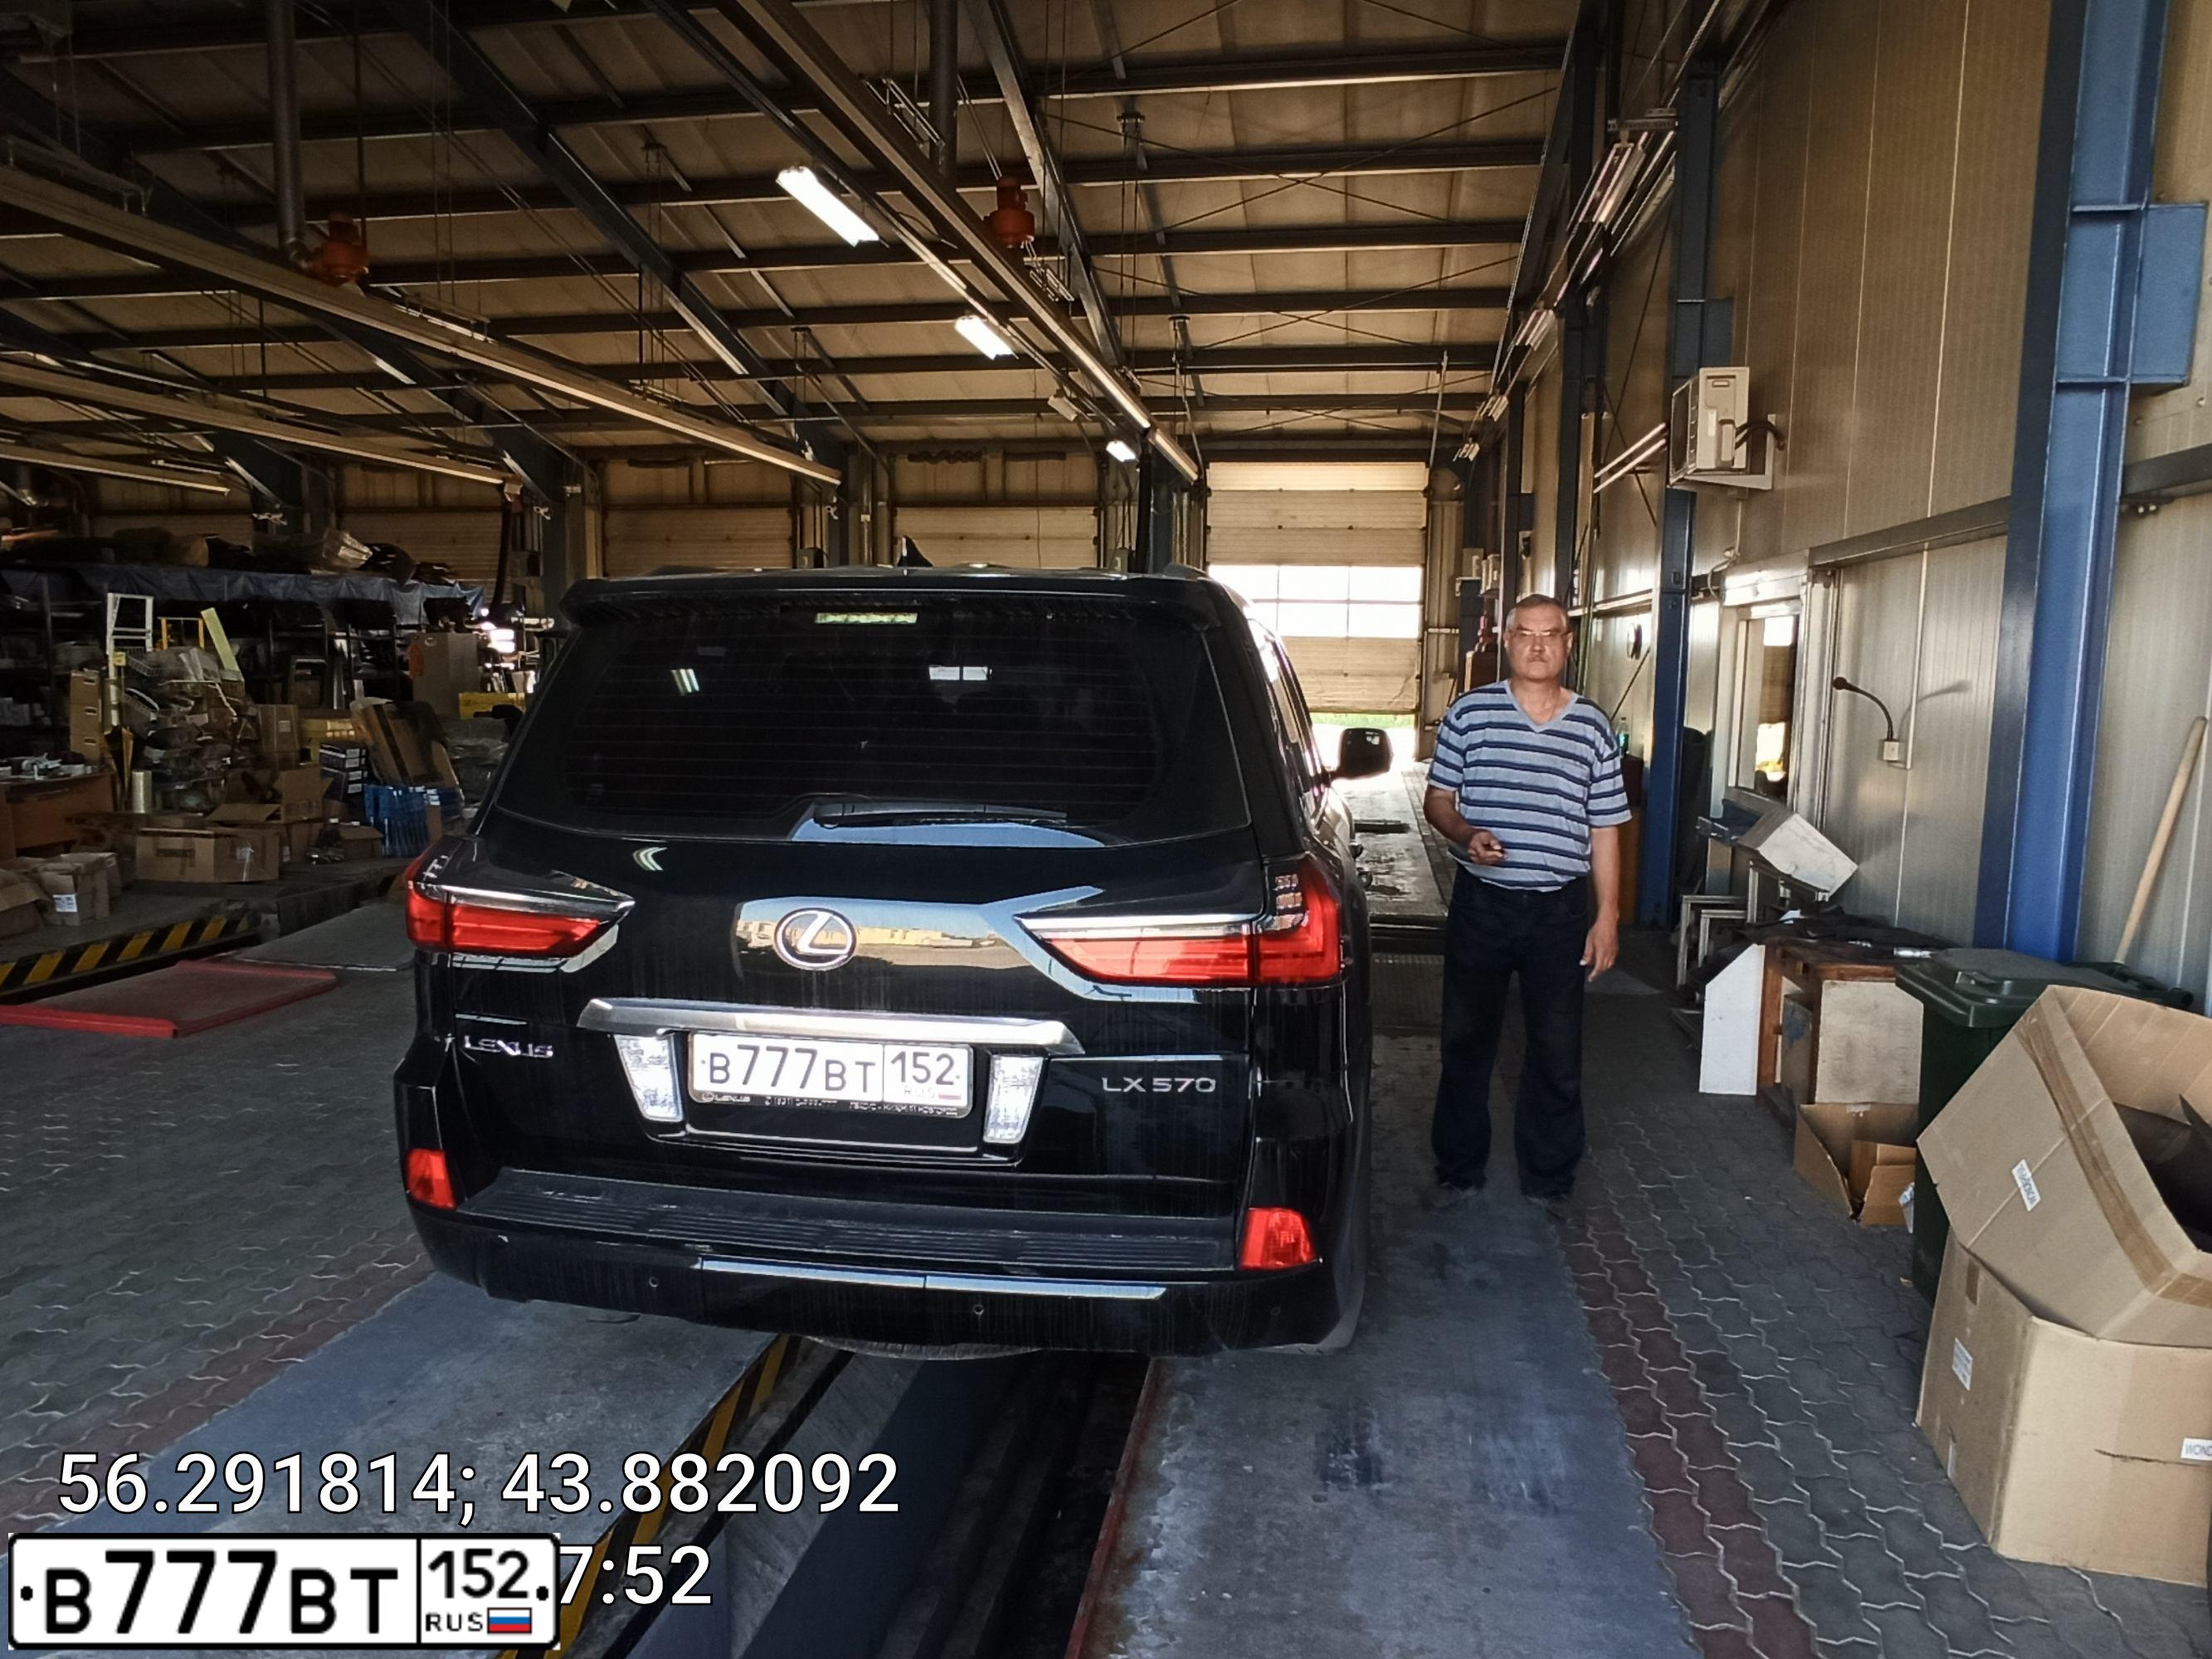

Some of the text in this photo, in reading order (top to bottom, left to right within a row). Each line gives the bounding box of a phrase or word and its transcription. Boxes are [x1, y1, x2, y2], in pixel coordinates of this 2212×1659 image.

[465, 1034, 553, 1058] LEXUS
[709, 1044, 955, 1093] В777ВТ 152
[1101, 1077, 1216, 1092] LX 570
